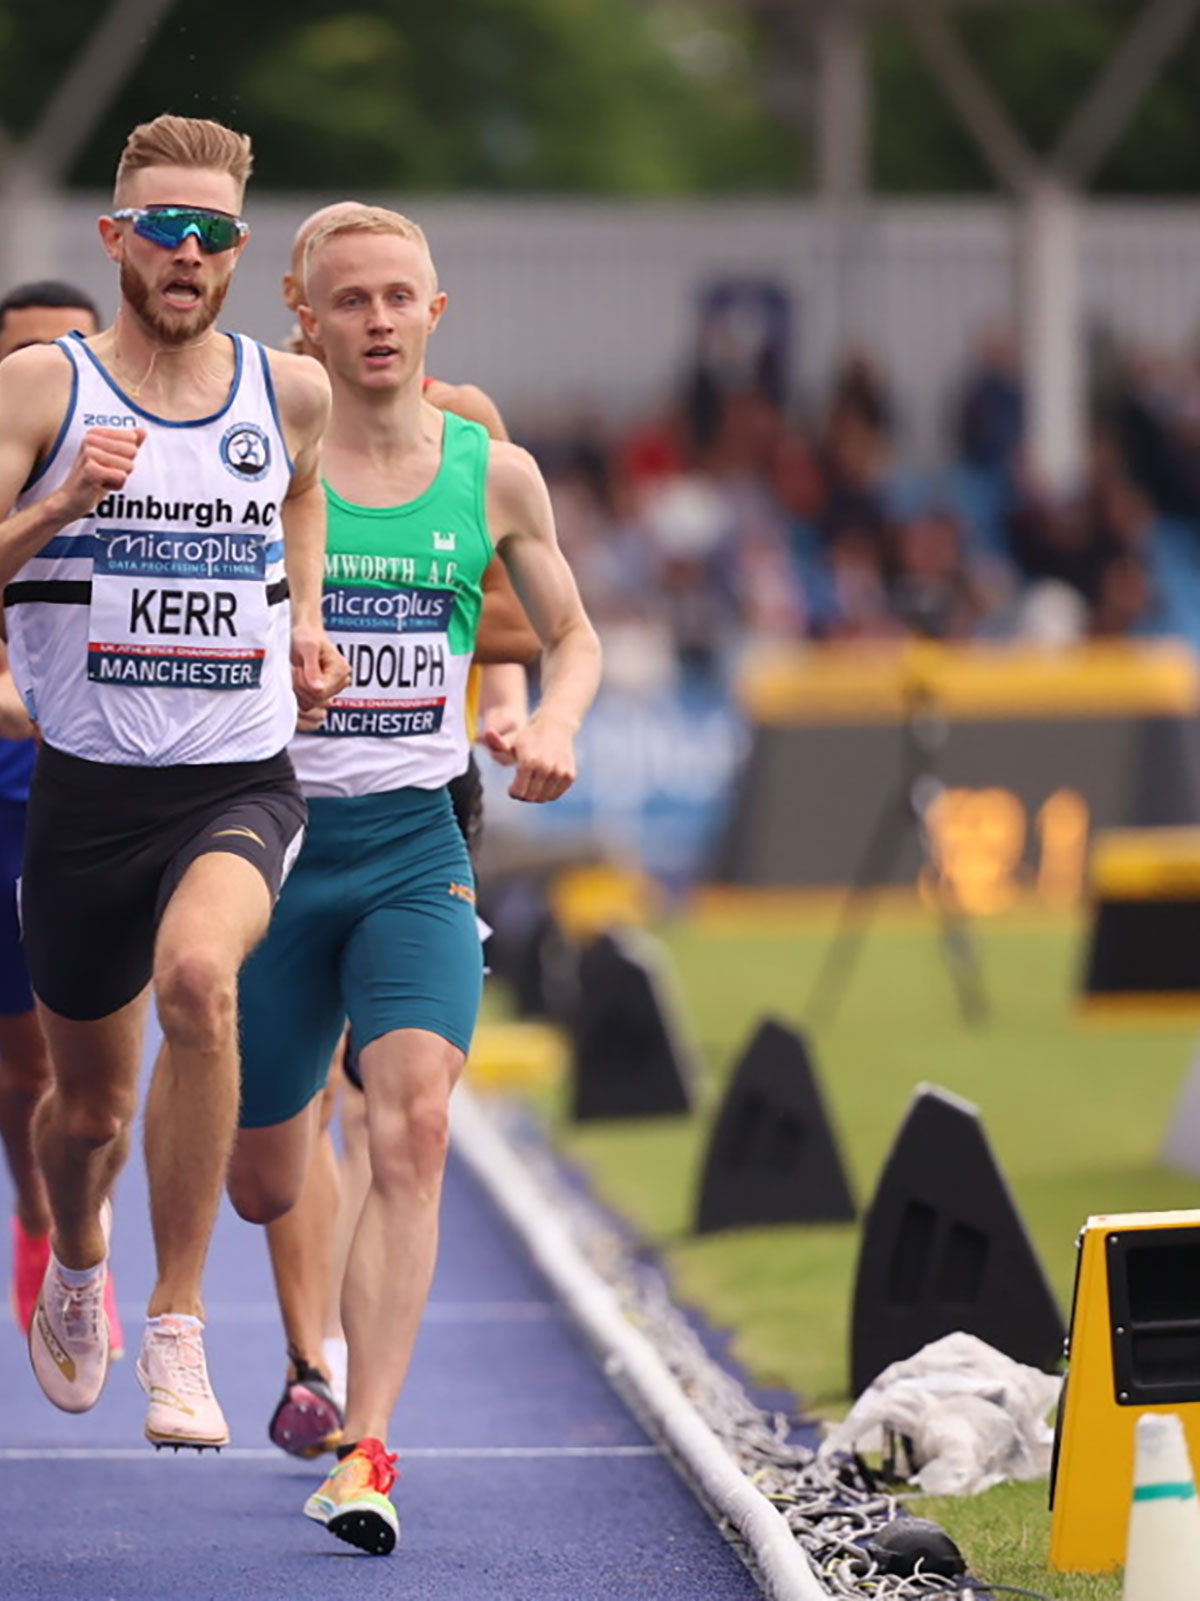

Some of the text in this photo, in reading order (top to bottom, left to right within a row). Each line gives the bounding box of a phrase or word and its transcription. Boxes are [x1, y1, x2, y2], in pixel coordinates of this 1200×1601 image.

[81, 494, 276, 528] dinburgh AC
[107, 534, 258, 576] Microplus
[130, 588, 237, 637] KERR
[100, 657, 253, 685] MANCHESTER
